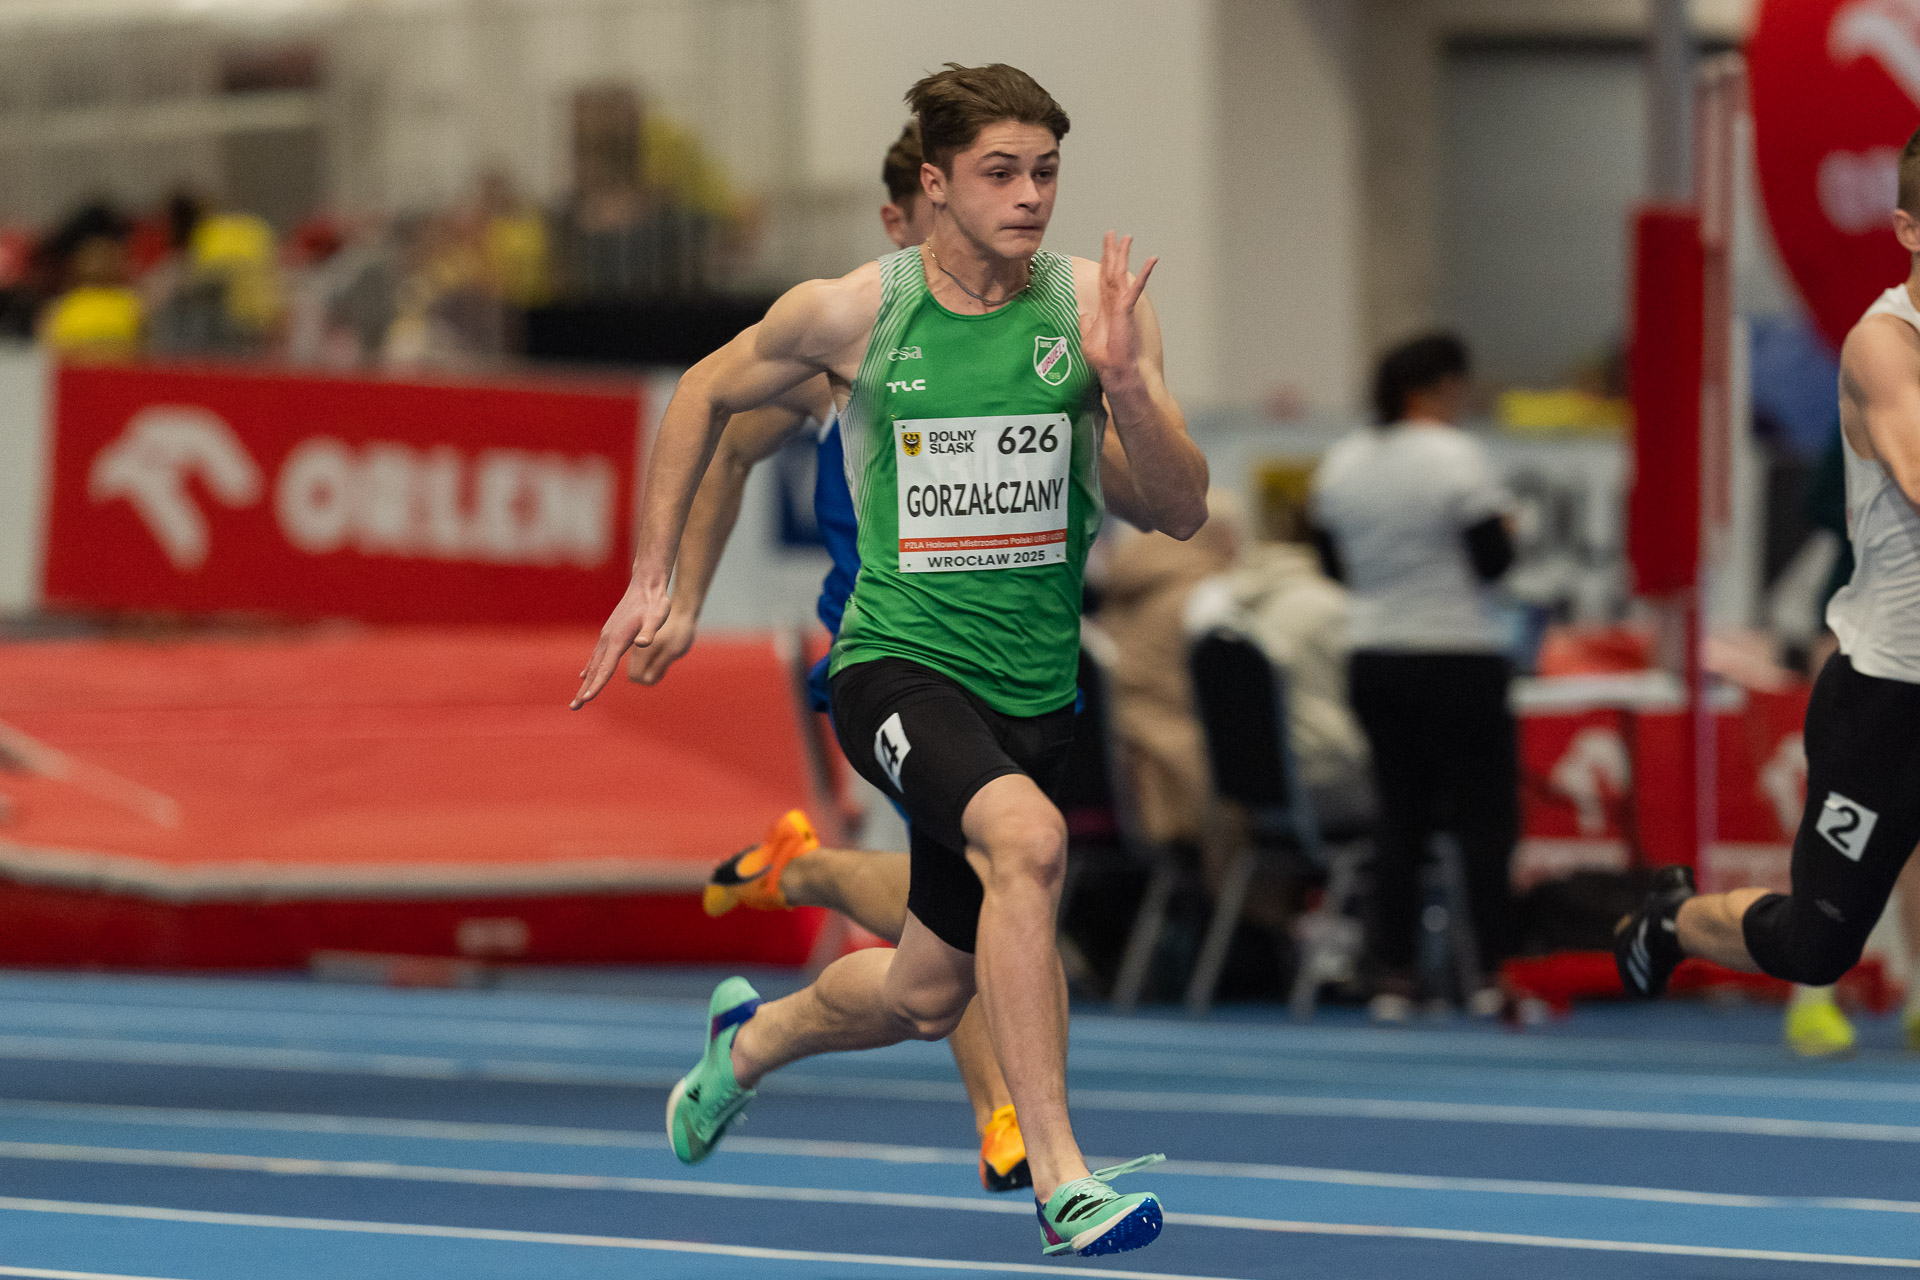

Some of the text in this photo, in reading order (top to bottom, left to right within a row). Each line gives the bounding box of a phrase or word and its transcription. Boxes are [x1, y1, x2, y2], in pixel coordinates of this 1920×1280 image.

[929, 430, 977, 442] DOLNY
[929, 441, 975, 455] ŚLĄSK
[997, 424, 1059, 455] 626
[907, 477, 1064, 518] GORZAŁCZANY
[904, 541, 925, 550] PZLA
[925, 540, 959, 549] Halowe
[959, 538, 1009, 548] Mistrzostwa
[1009, 535, 1033, 545] Polski
[927, 550, 1046, 568] WROCŁAW 2025
[881, 729, 899, 774] 4
[1827, 806, 1861, 850] 2
